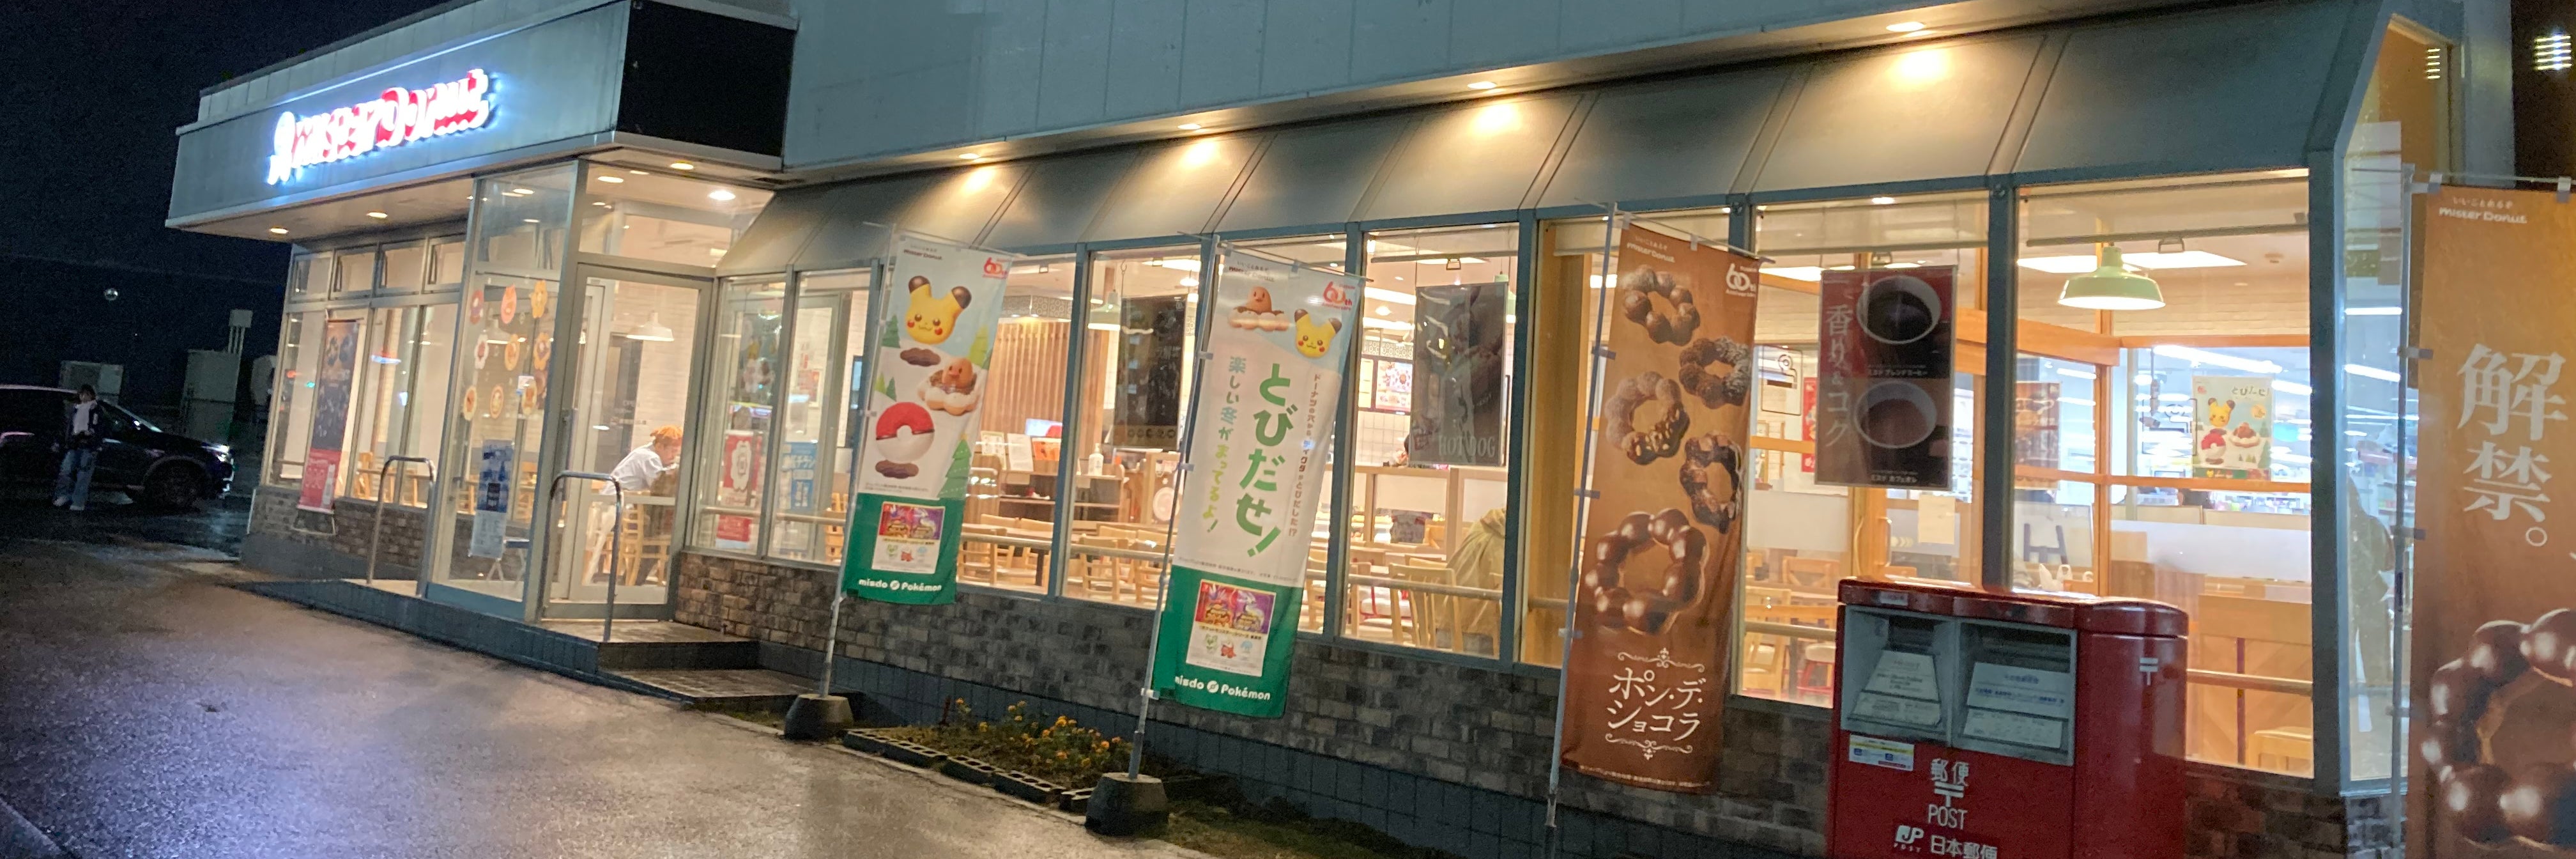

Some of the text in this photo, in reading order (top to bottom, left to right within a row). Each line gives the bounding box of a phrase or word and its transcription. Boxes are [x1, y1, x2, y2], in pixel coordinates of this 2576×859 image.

[2457, 343, 2569, 547] 解禁。
[1236, 363, 1298, 557] とびだせ!
[1221, 684, 1271, 700] Pokémon
[1607, 700, 1701, 741] ショコラ
[1931, 758, 1970, 787] 郵便
[1928, 804, 1968, 830] POST
[1930, 835, 1998, 859] 日本郵便
